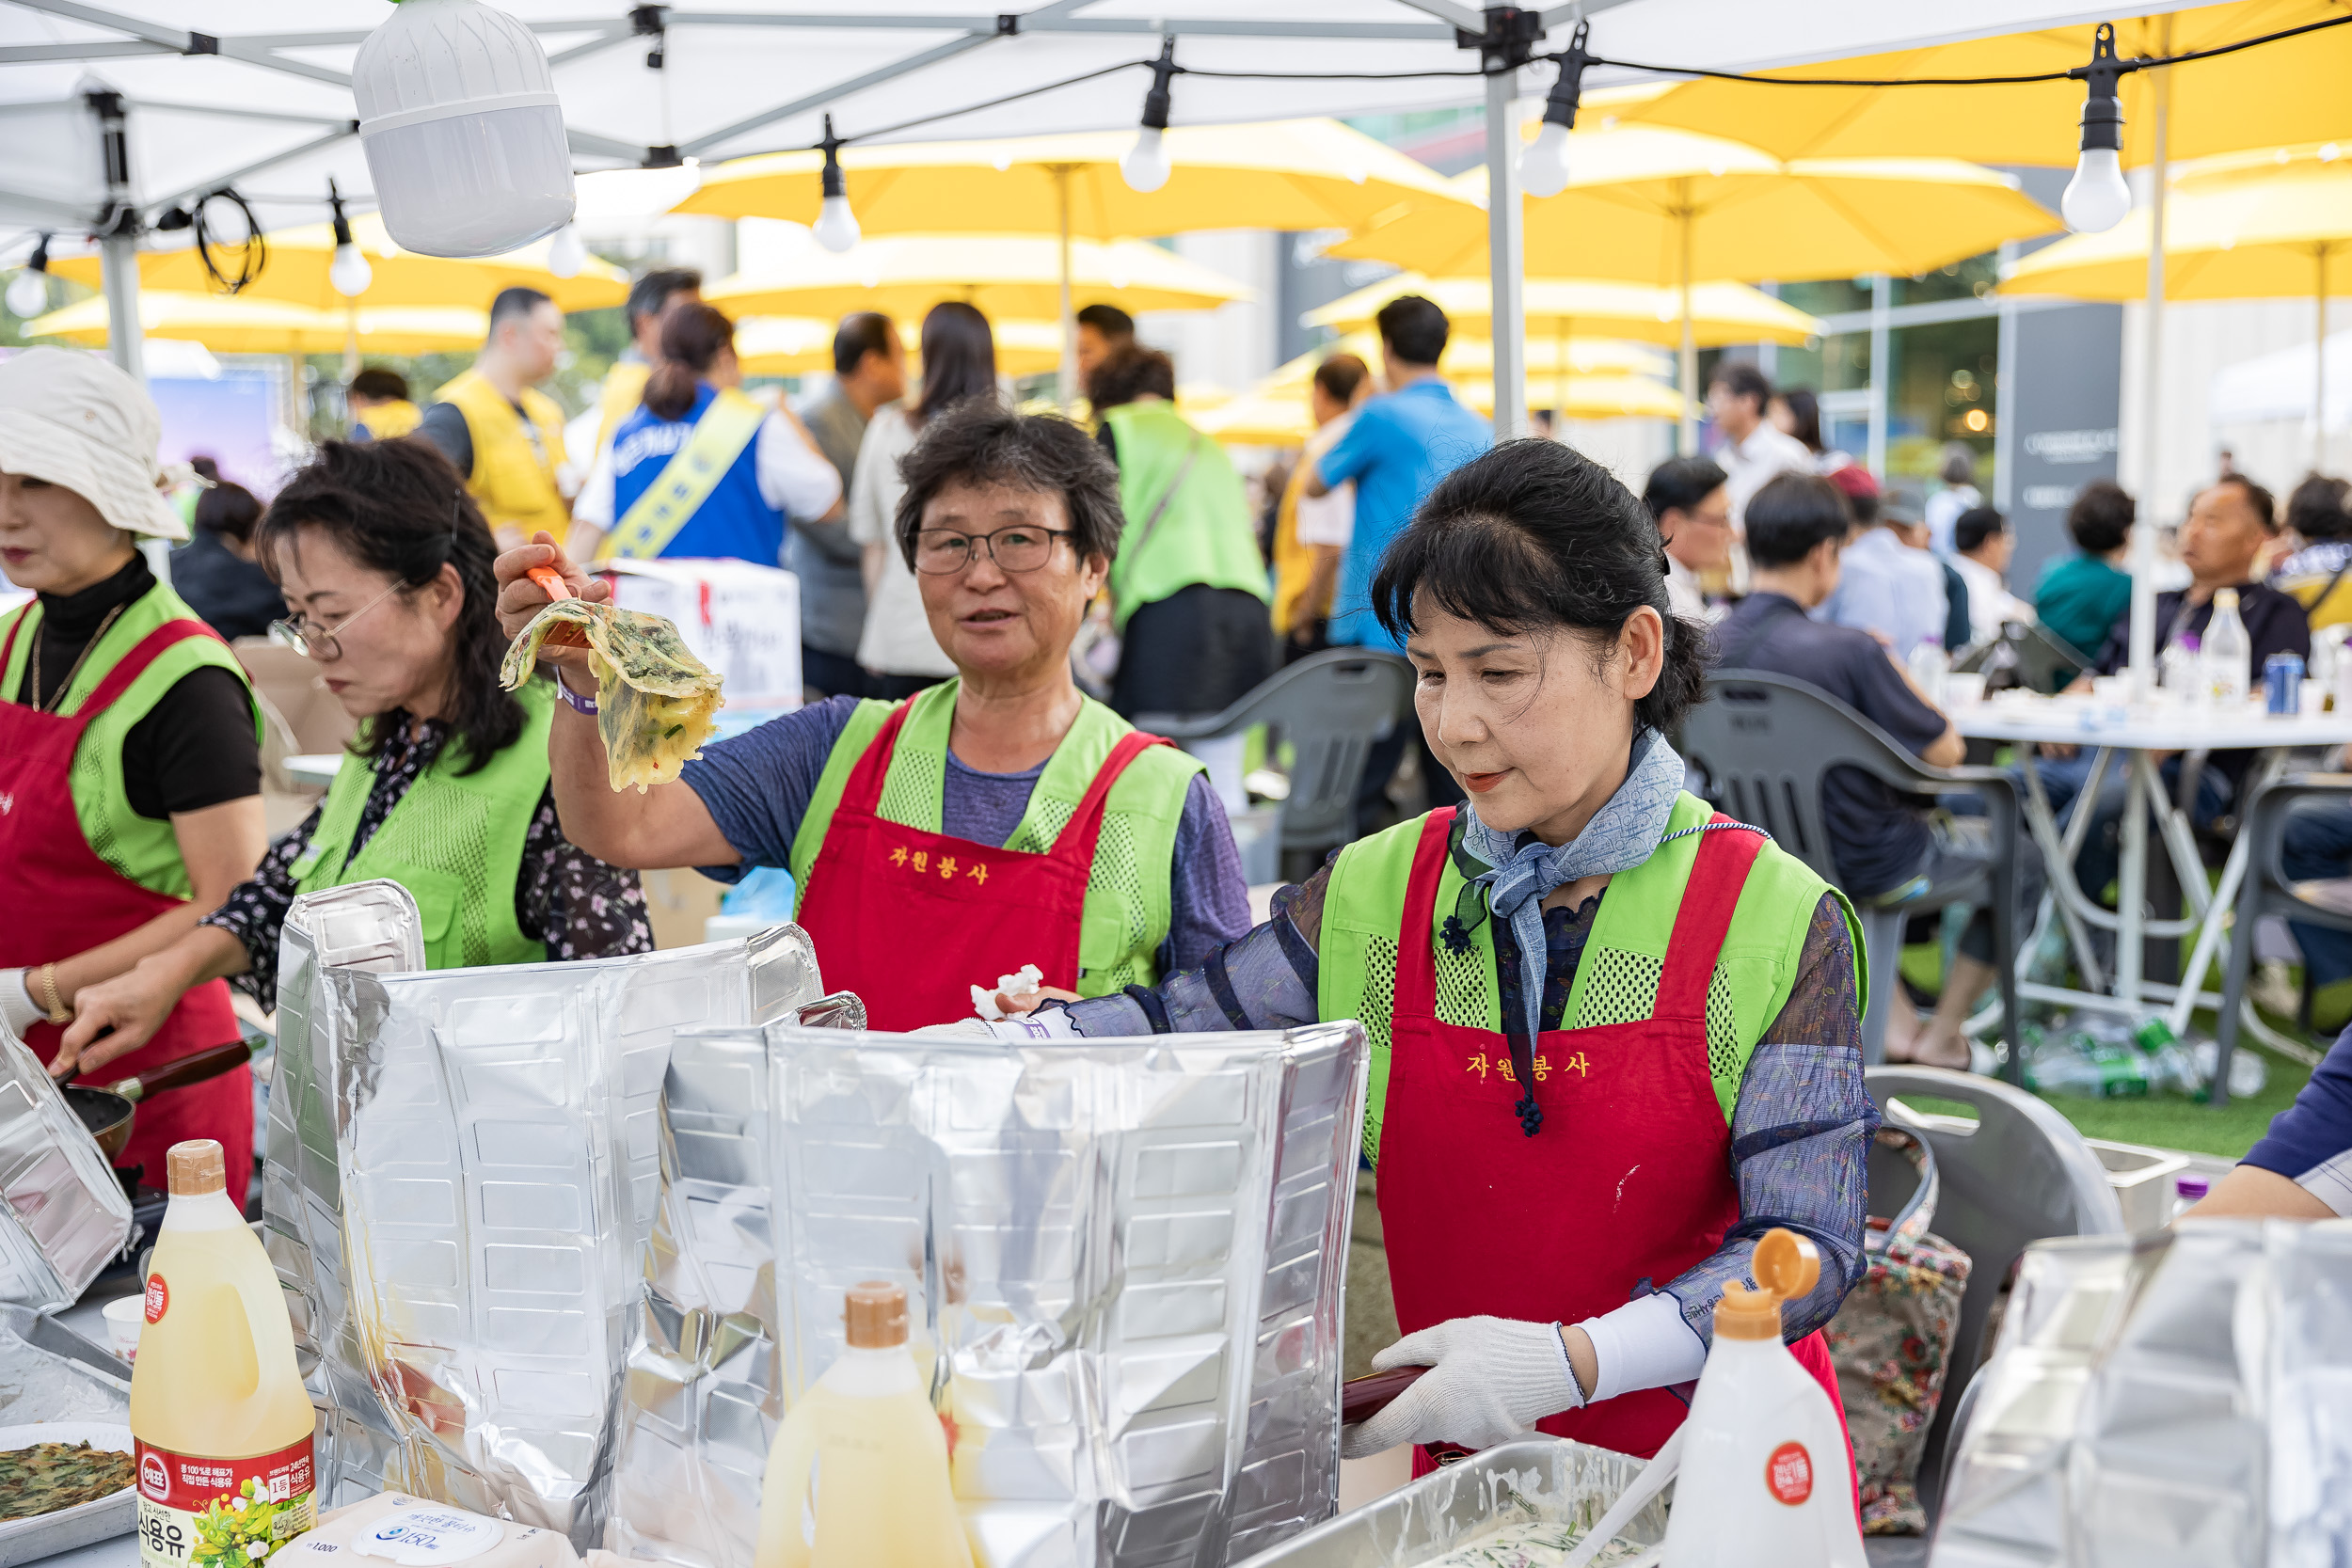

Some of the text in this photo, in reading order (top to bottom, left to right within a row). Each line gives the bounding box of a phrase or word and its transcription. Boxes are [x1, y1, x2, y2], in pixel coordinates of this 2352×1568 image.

[888, 846, 989, 885] 자원봉사
[143, 1465, 165, 1487] 해표
[182, 1474, 233, 1488] 직접 만든 식용유
[290, 1465, 310, 1485] 식용유
[272, 1479, 288, 1494] 1등
[138, 1511, 185, 1559] 식용유
[398, 1532, 437, 1546] 150
